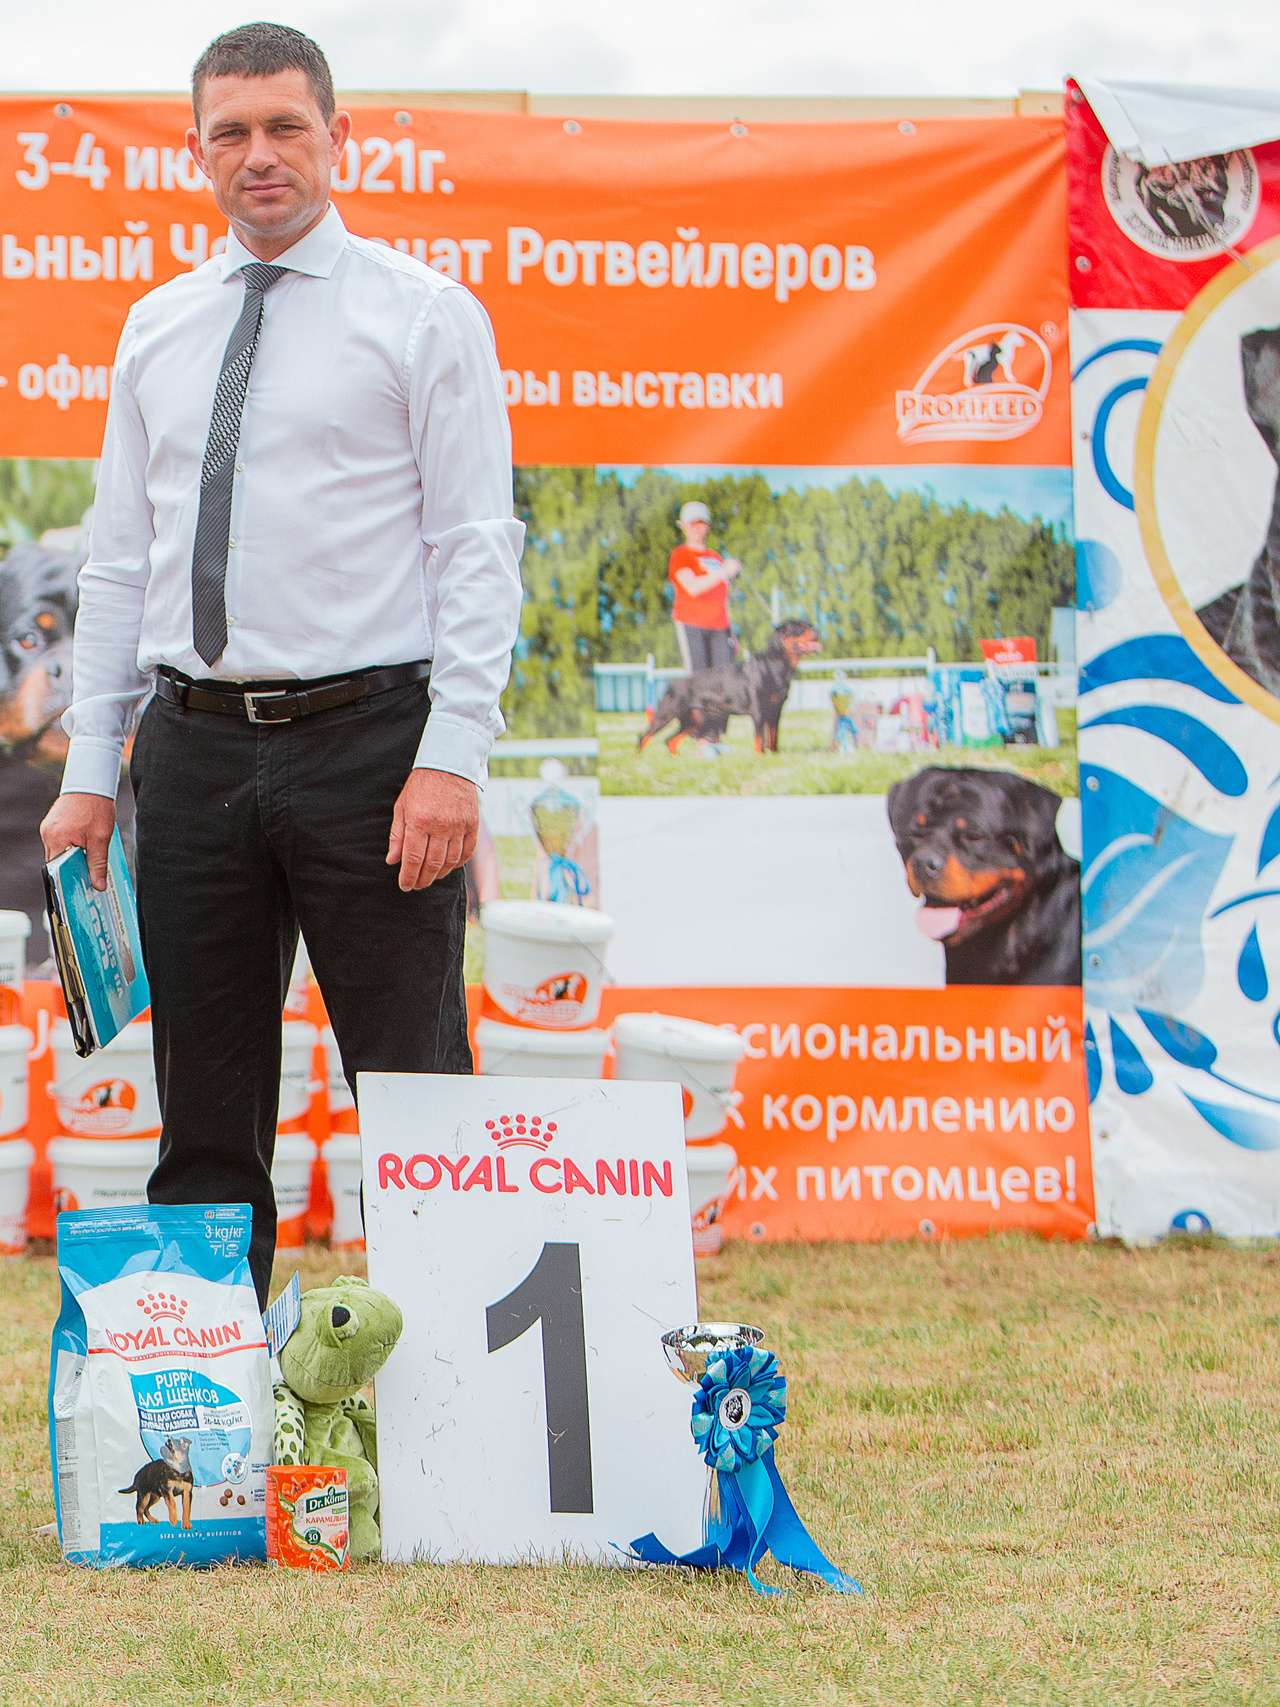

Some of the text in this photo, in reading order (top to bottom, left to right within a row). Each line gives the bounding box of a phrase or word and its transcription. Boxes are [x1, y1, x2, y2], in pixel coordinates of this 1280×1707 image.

[15, 131, 111, 191] 3-4
[329, 136, 456, 194] 021г.
[506, 226, 877, 303] Ротвейлеров
[572, 368, 783, 409] выставки
[762, 1093, 1076, 1143] кормлению
[377, 1152, 674, 1197] ROYAL CANIN
[796, 1156, 1077, 1209] питомцев!
[205, 1225, 212, 1239] 3
[173, 1321, 242, 1349] CANIN
[155, 1371, 193, 1390] PUPPY
[484, 1241, 594, 1514] 1
[138, 1387, 220, 1408] ДЛЯ ЩЕНКОВ
[170, 1408, 194, 1419] СОБАК
[165, 1418, 198, 1430] РАЗМЕРОВ
[308, 1533, 319, 1542] 30
